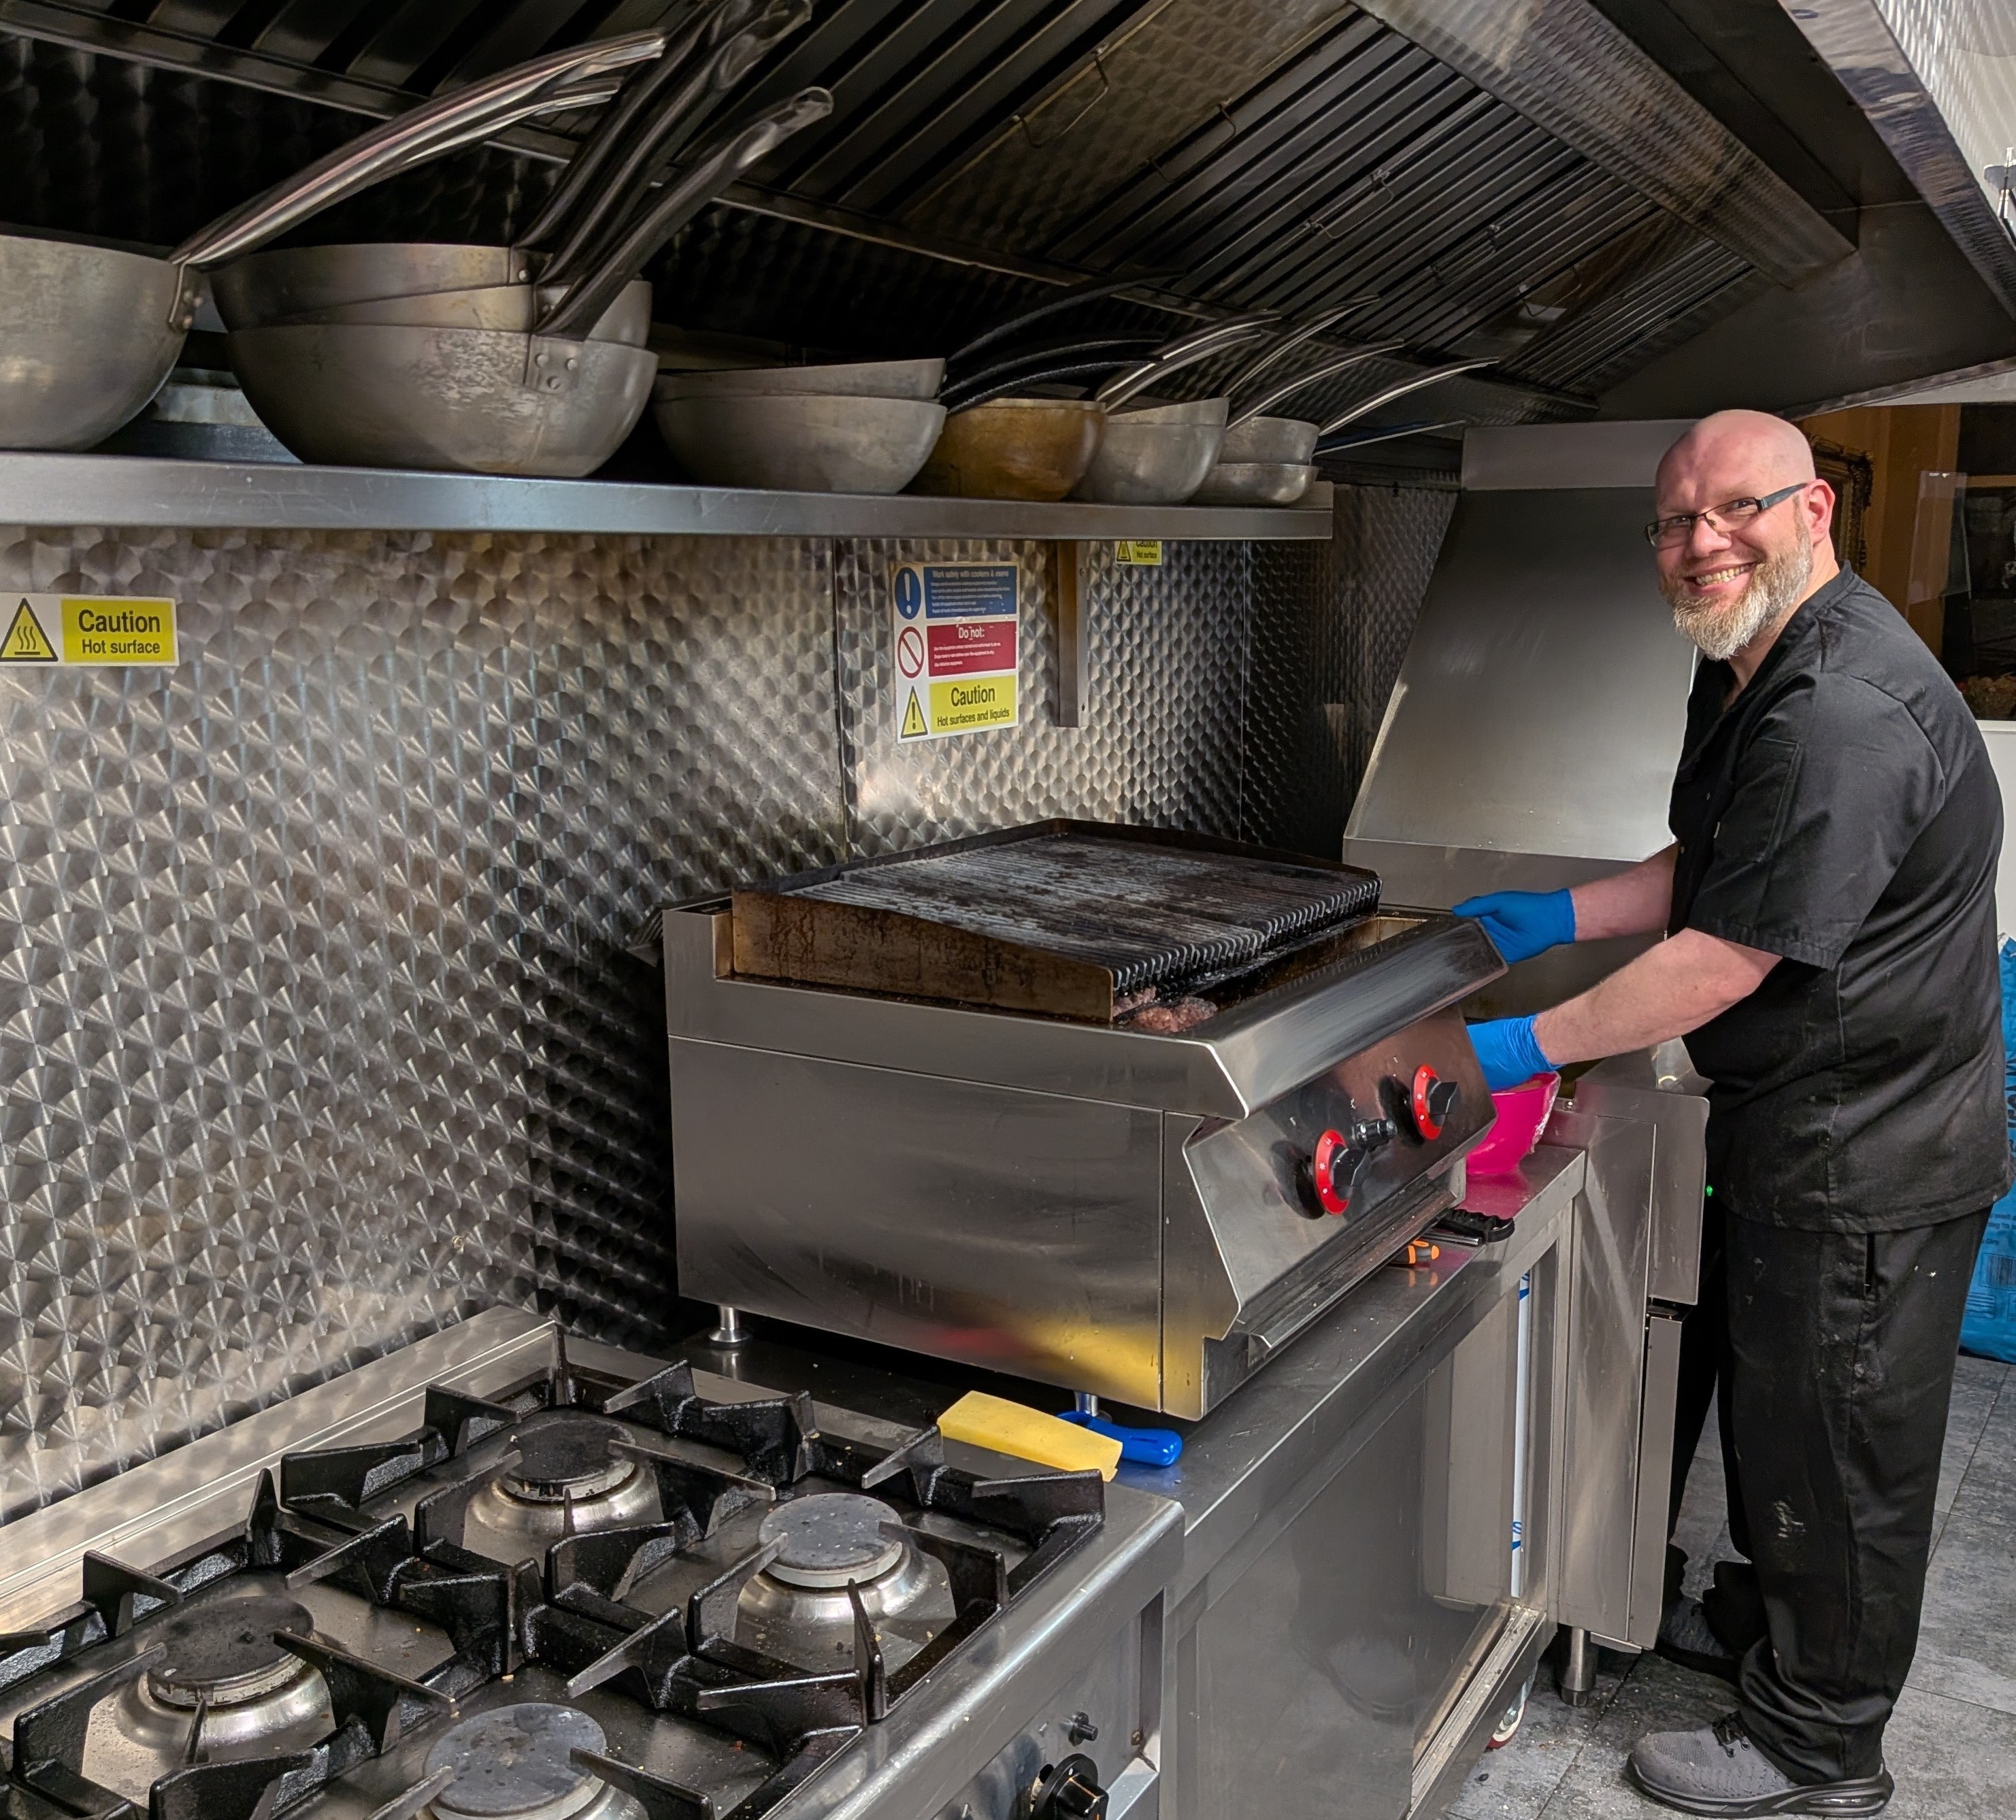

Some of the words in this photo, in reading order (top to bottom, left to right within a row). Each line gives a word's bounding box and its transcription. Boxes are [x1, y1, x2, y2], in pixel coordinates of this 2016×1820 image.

[78, 609, 161, 633] Caution
[959, 627, 969, 638] Do
[970, 626, 985, 638] not:
[82, 639, 106, 654] Hot
[110, 640, 161, 654] surface
[951, 684, 995, 707] Caution
[937, 716, 948, 727] Hot
[950, 713, 976, 725] surfaces
[977, 710, 988, 721] and
[990, 708, 1010, 721] liquids
